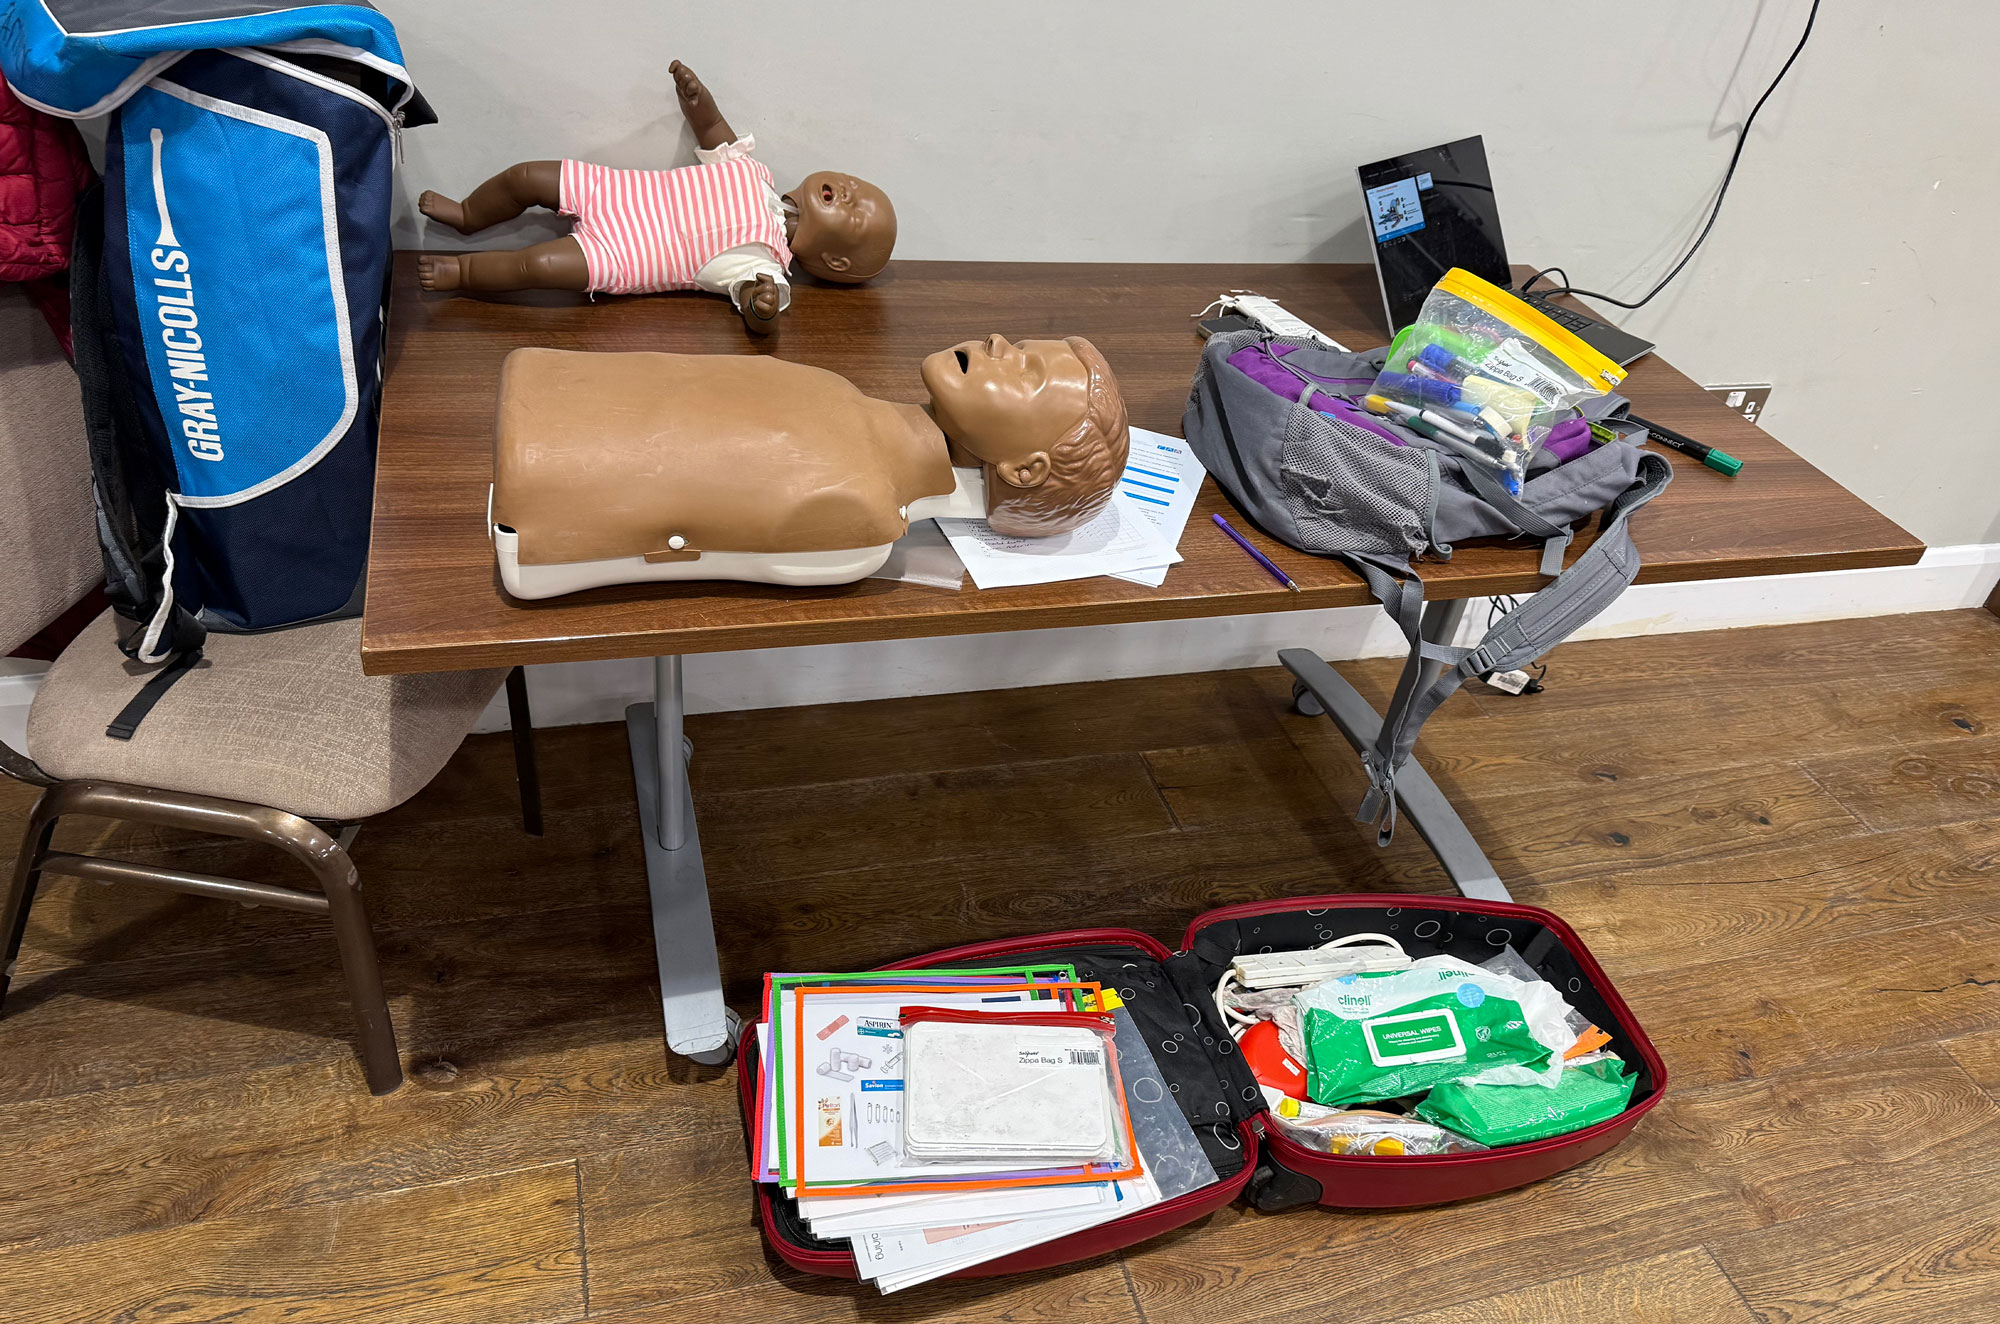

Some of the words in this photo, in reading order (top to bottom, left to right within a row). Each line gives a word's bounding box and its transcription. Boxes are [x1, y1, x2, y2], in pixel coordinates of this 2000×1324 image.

[151, 248, 225, 462] GRAY-NICOLLS
[1485, 362, 1504, 376] Zippa
[1502, 370, 1518, 381] Bag
[1337, 994, 1372, 1006] clinell
[864, 1019, 893, 1029] ASPIRIN
[1382, 1029, 1419, 1040] UNIVERSAL
[1420, 1026, 1442, 1036] WIPES
[1018, 1056, 1040, 1065] Zippa
[1040, 1056, 1056, 1065] Bag
[1057, 1056, 1063, 1064] S
[871, 1232, 885, 1261] aining
